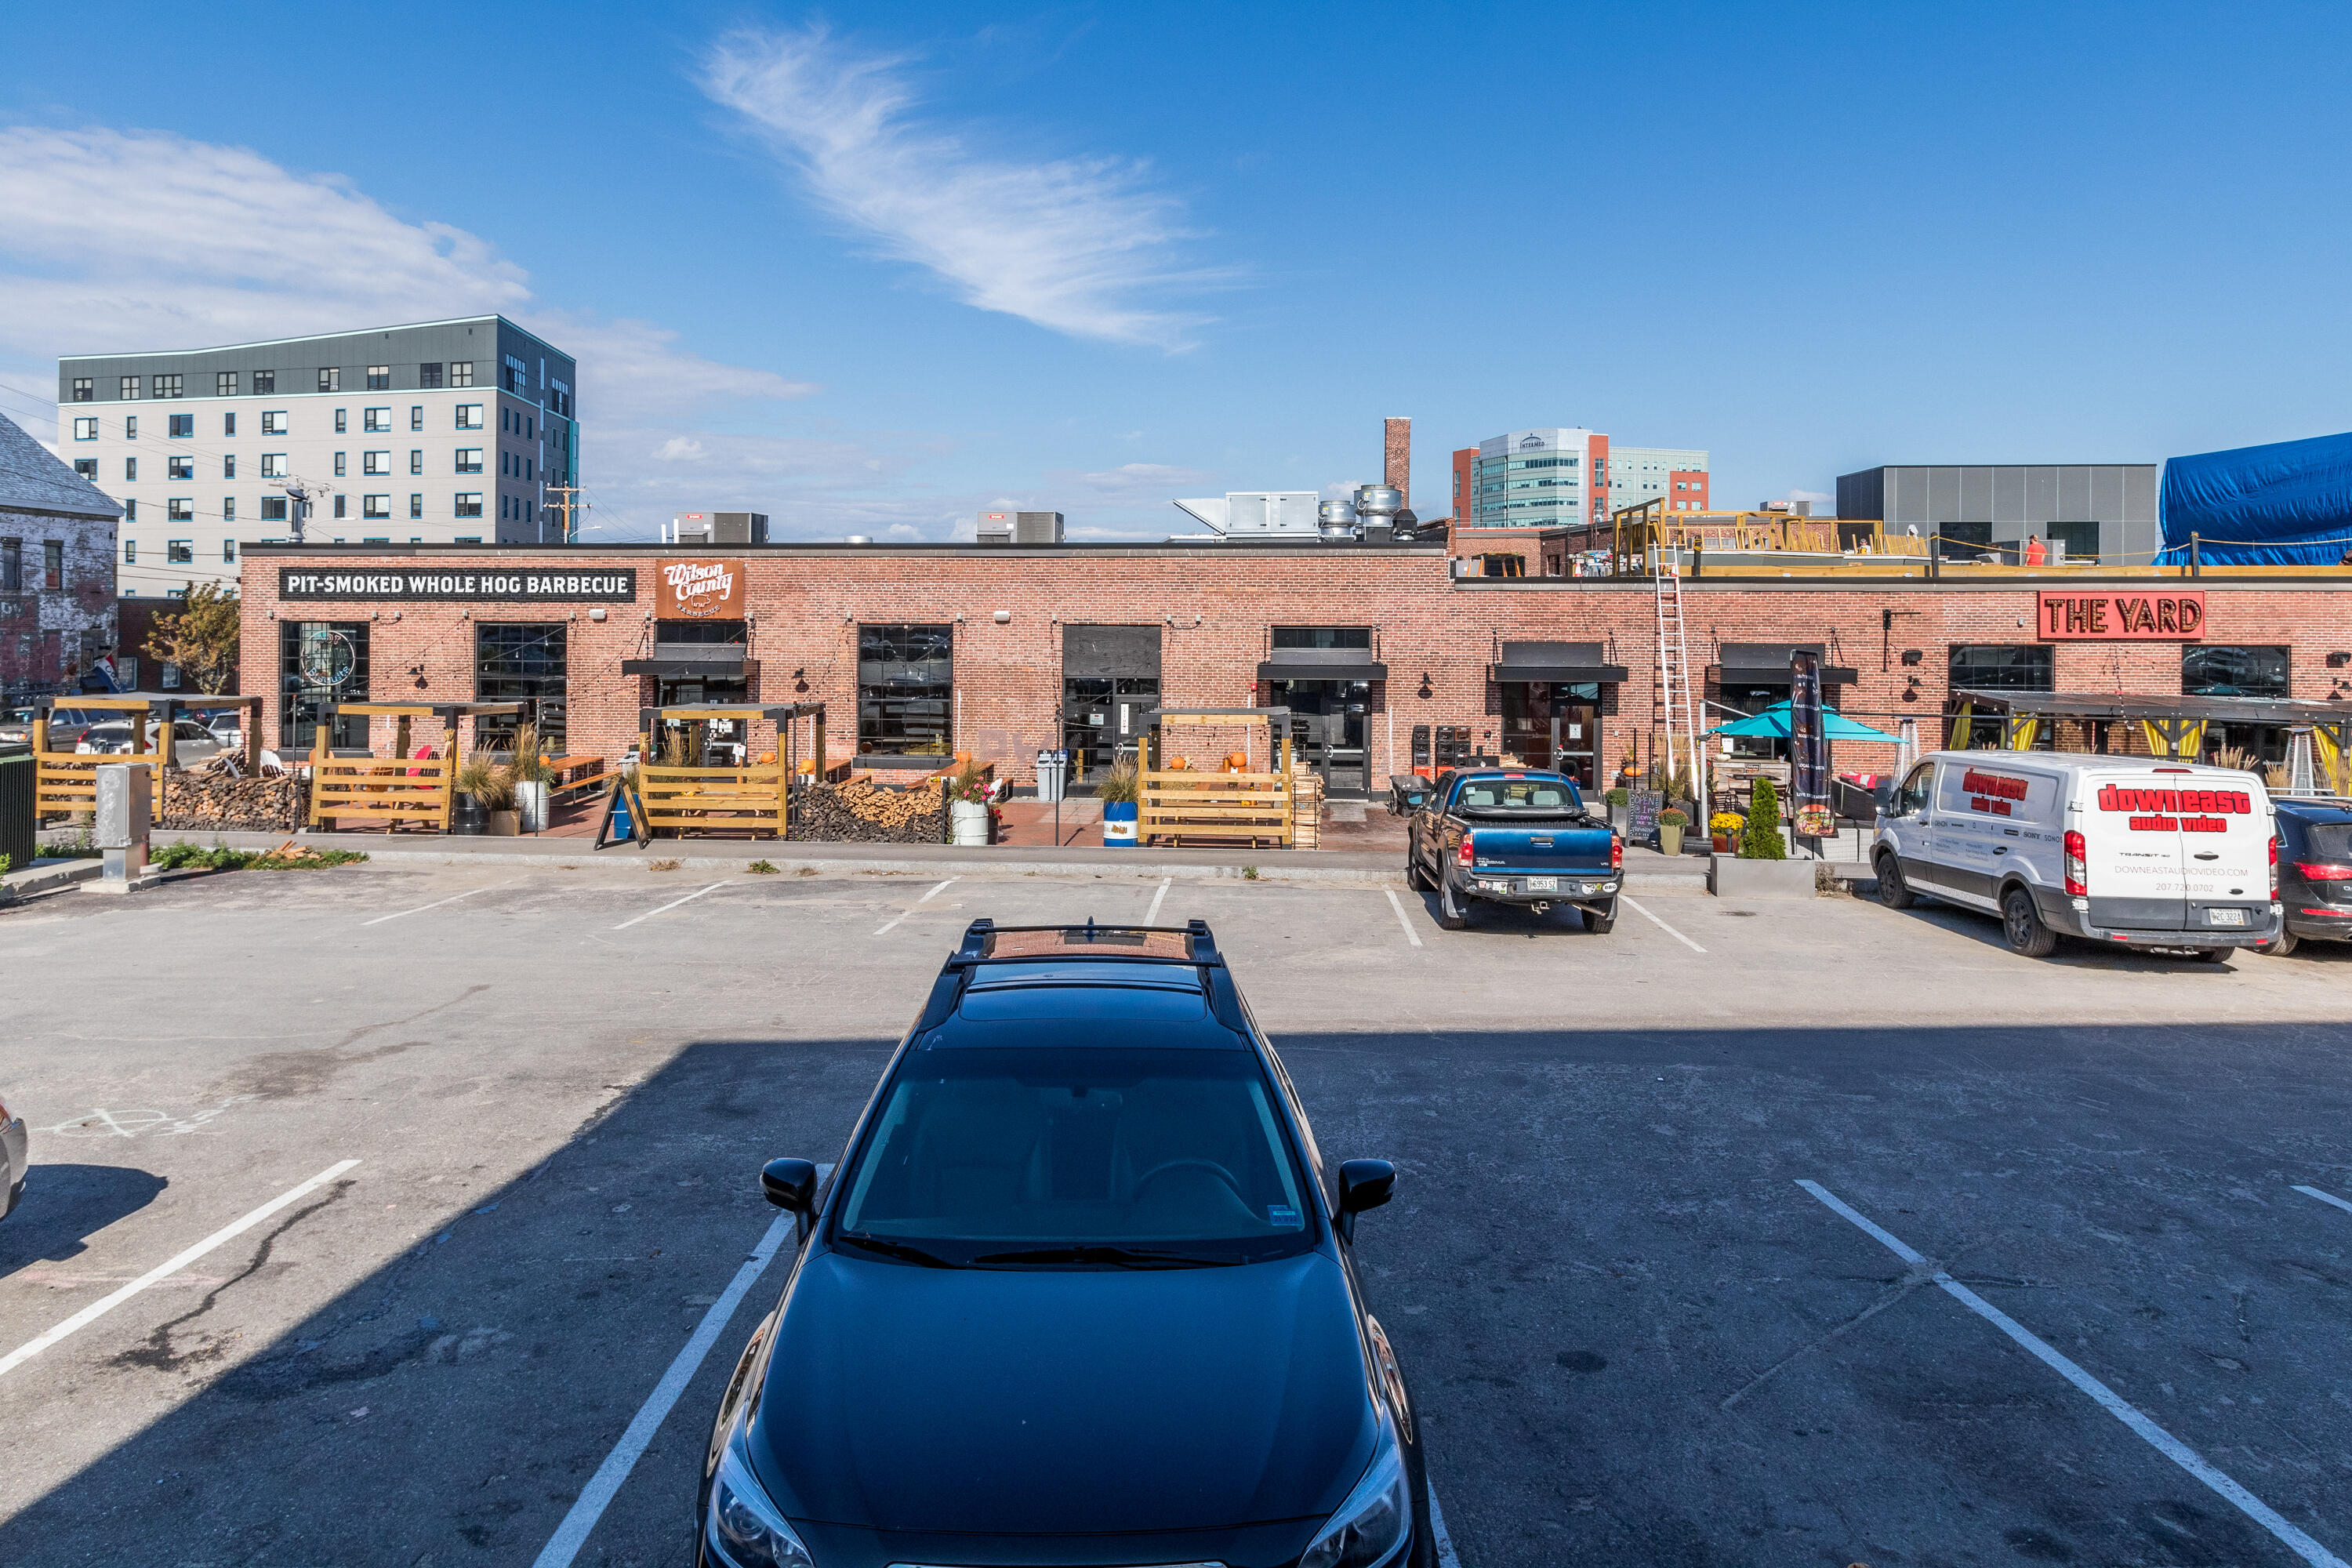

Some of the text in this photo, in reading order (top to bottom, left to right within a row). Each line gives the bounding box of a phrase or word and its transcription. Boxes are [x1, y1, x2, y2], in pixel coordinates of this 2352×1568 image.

[663, 563, 724, 586] Wilson
[288, 575, 628, 594] PIT-SMOKED WHOLE HOG BARBECUE
[676, 572, 734, 601] County
[676, 603, 721, 616] BARBECUE
[2045, 598, 2202, 633] THE YARD
[1634, 796, 1655, 805] OPEN
[2097, 783, 2252, 814] downeast
[2129, 814, 2227, 833] audio video
[2044, 835, 2063, 844] SONOS
[2114, 866, 2249, 877] DOWNEASTAUDIOVIDEO.COM
[2156, 883, 2214, 892] 207.720.0702
